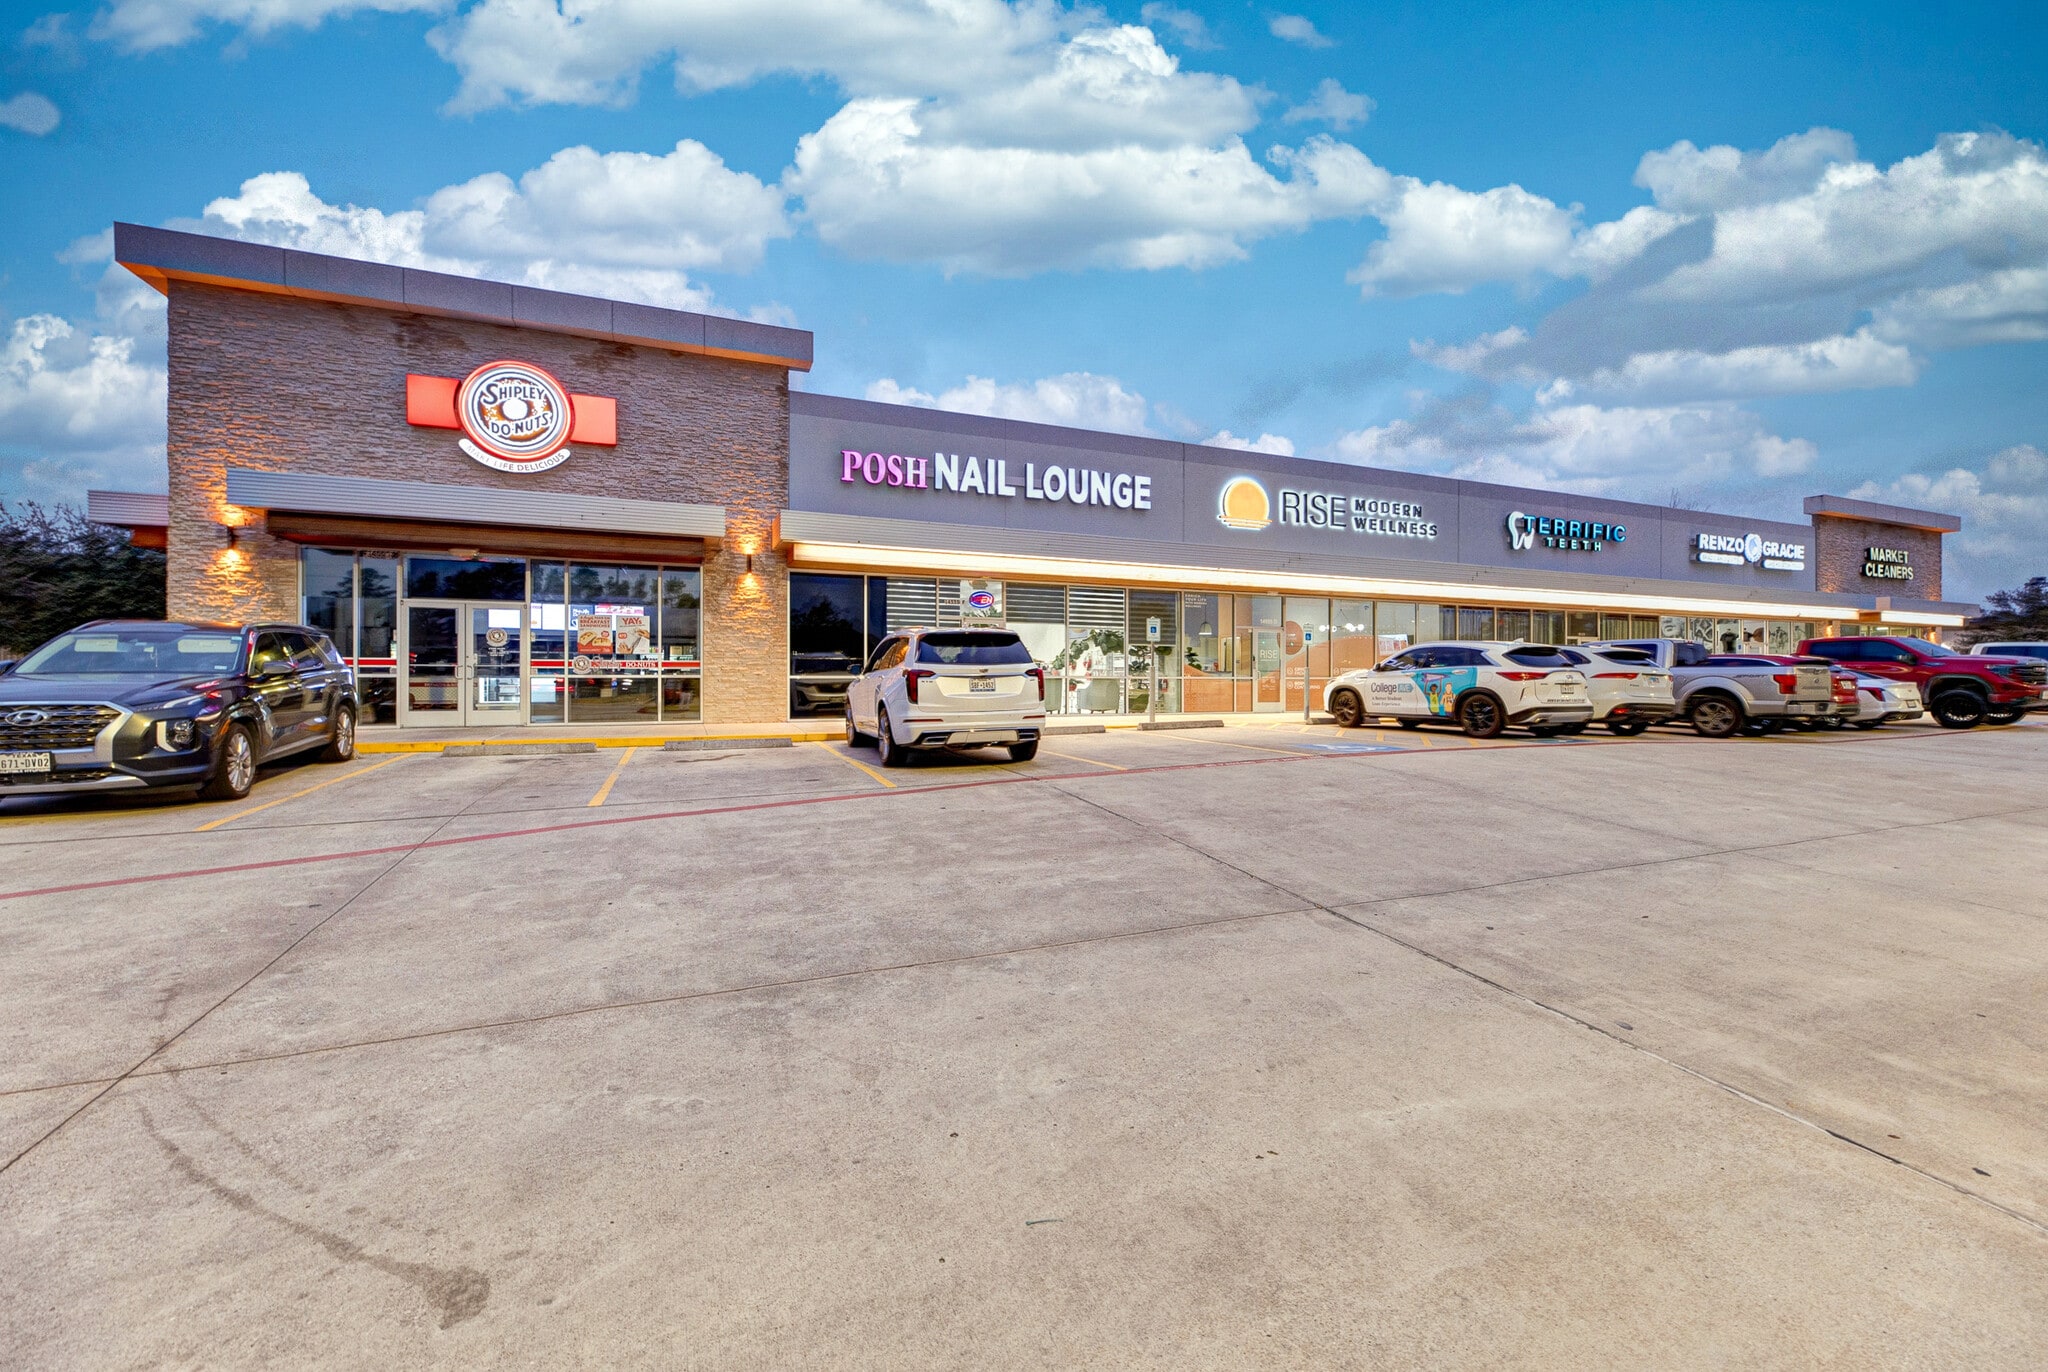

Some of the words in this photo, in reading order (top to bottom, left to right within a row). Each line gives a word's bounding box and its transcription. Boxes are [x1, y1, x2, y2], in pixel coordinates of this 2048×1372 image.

[483, 382, 546, 406] SHIPLEY
[490, 412, 550, 437] DO-NUTS
[516, 452, 566, 472] DELICIOUS
[840, 449, 929, 489] POSH
[934, 452, 1016, 497] NAIL
[1025, 461, 1152, 510] LOUNGE
[1281, 490, 1347, 528] RISE
[1353, 499, 1423, 518] MODERN
[1353, 517, 1438, 537] WELLNESS
[1523, 515, 1627, 542] TERRIFIC
[1545, 536, 1602, 552] TEETH
[1699, 533, 1745, 553] RENZO
[1762, 540, 1805, 560] GRACIE
[1868, 547, 1909, 565] MARKET
[1864, 562, 1914, 581] CLEANERS
[971, 595, 994, 605] EN
[1260, 649, 1278, 659] RISE
[1371, 682, 1397, 694] College
